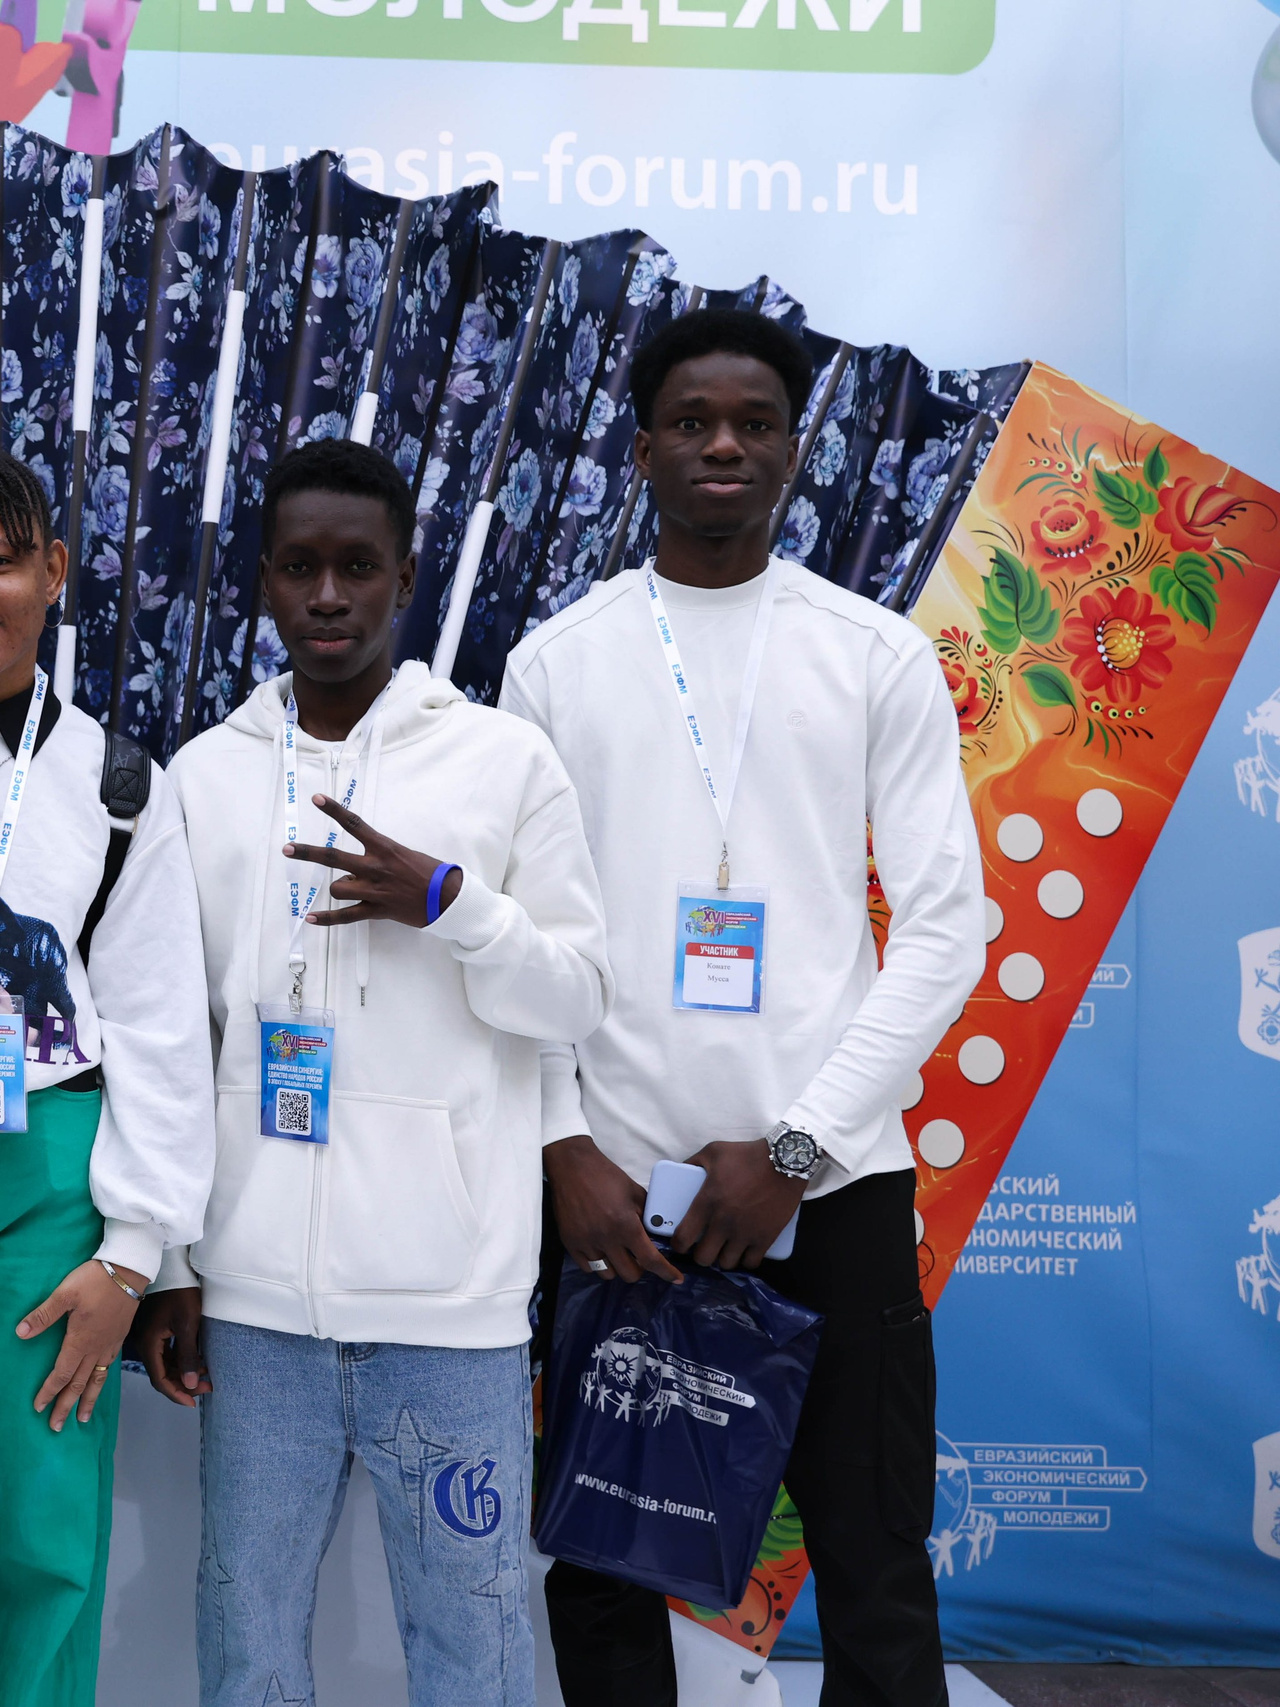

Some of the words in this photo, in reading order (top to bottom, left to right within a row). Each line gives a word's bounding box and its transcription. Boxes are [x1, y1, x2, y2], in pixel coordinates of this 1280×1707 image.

[213, 130, 918, 216] asia-forum.ru
[658, 616, 672, 645] ЕЭФМ
[672, 664, 688, 694] ЕЭФМ
[22, 720, 36, 750] ЕЭФМ
[286, 720, 294, 749] ЕЭФМ
[687, 715, 702, 746] ЕЭФМ
[10, 770, 24, 802] ЕЭФМ
[287, 771, 296, 804] ЕЭФМ
[288, 826, 296, 843] ЕЭ
[290, 883, 299, 916] ЕЭФМ
[702, 910, 725, 924] XVI
[700, 944, 739, 957] УЧАСТНИК
[976, 1201, 1137, 1224] ДАРСТВЕННЫЙ
[672, 1382, 702, 1403] ФОРУМ
[974, 1449, 1094, 1464] ЕВРАЗИЙСКИЙ
[983, 1470, 1130, 1485] ЭКОНОМИЧЕСКИЙ
[992, 1490, 1051, 1503] ФОРУМ
[1003, 1510, 1099, 1525] МОЛОДЕЖИ
